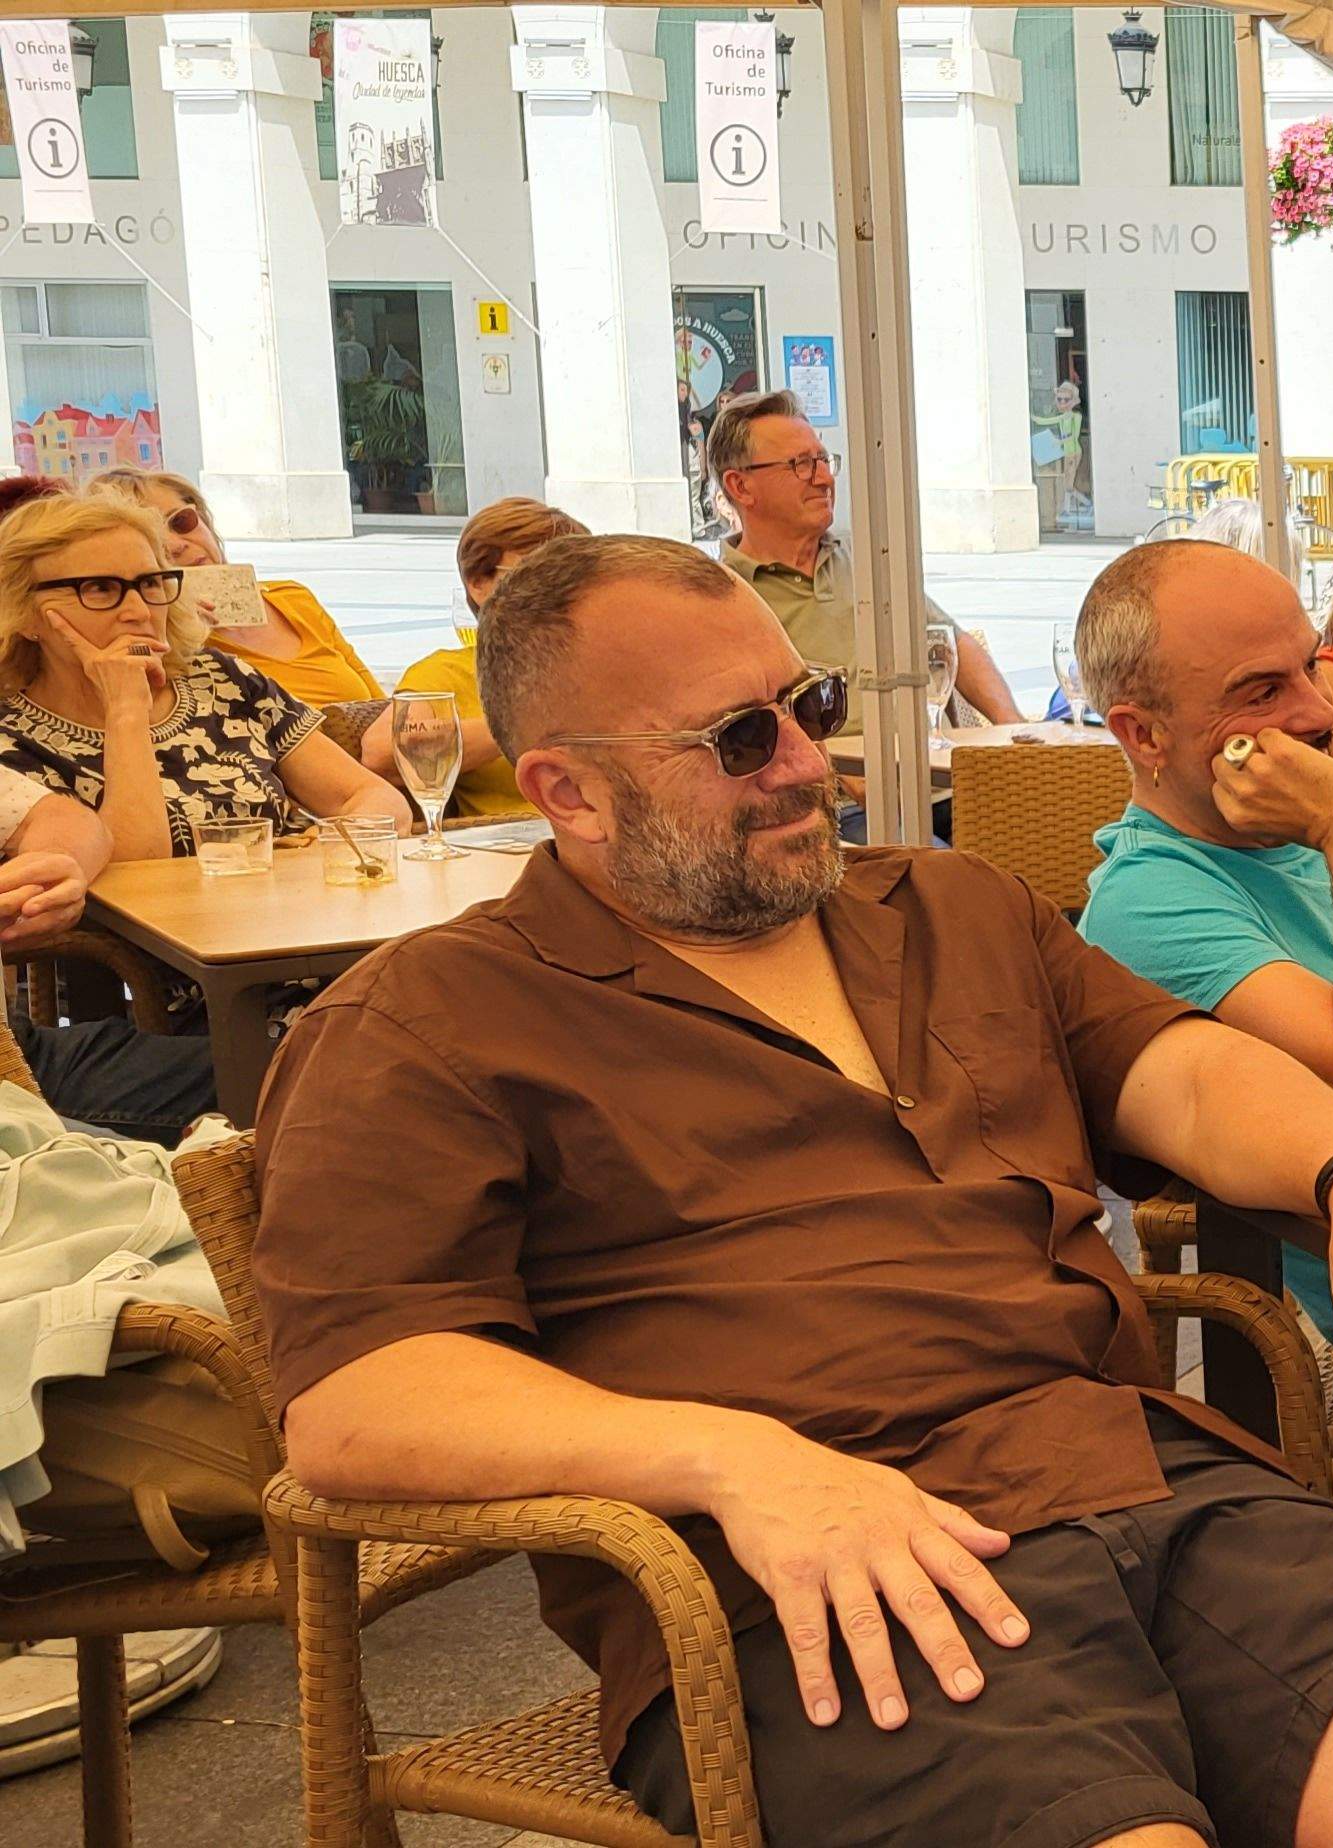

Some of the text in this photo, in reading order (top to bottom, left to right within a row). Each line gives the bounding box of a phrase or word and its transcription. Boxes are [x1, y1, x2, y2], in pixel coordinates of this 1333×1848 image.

[16, 41, 66, 54] Oficina
[713, 44, 765, 59] Oficina
[52, 59, 69, 72] de
[378, 61, 425, 83] HUESCA
[747, 64, 766, 78] de
[16, 78, 71, 91] Turismo
[705, 82, 766, 96] Turismo
